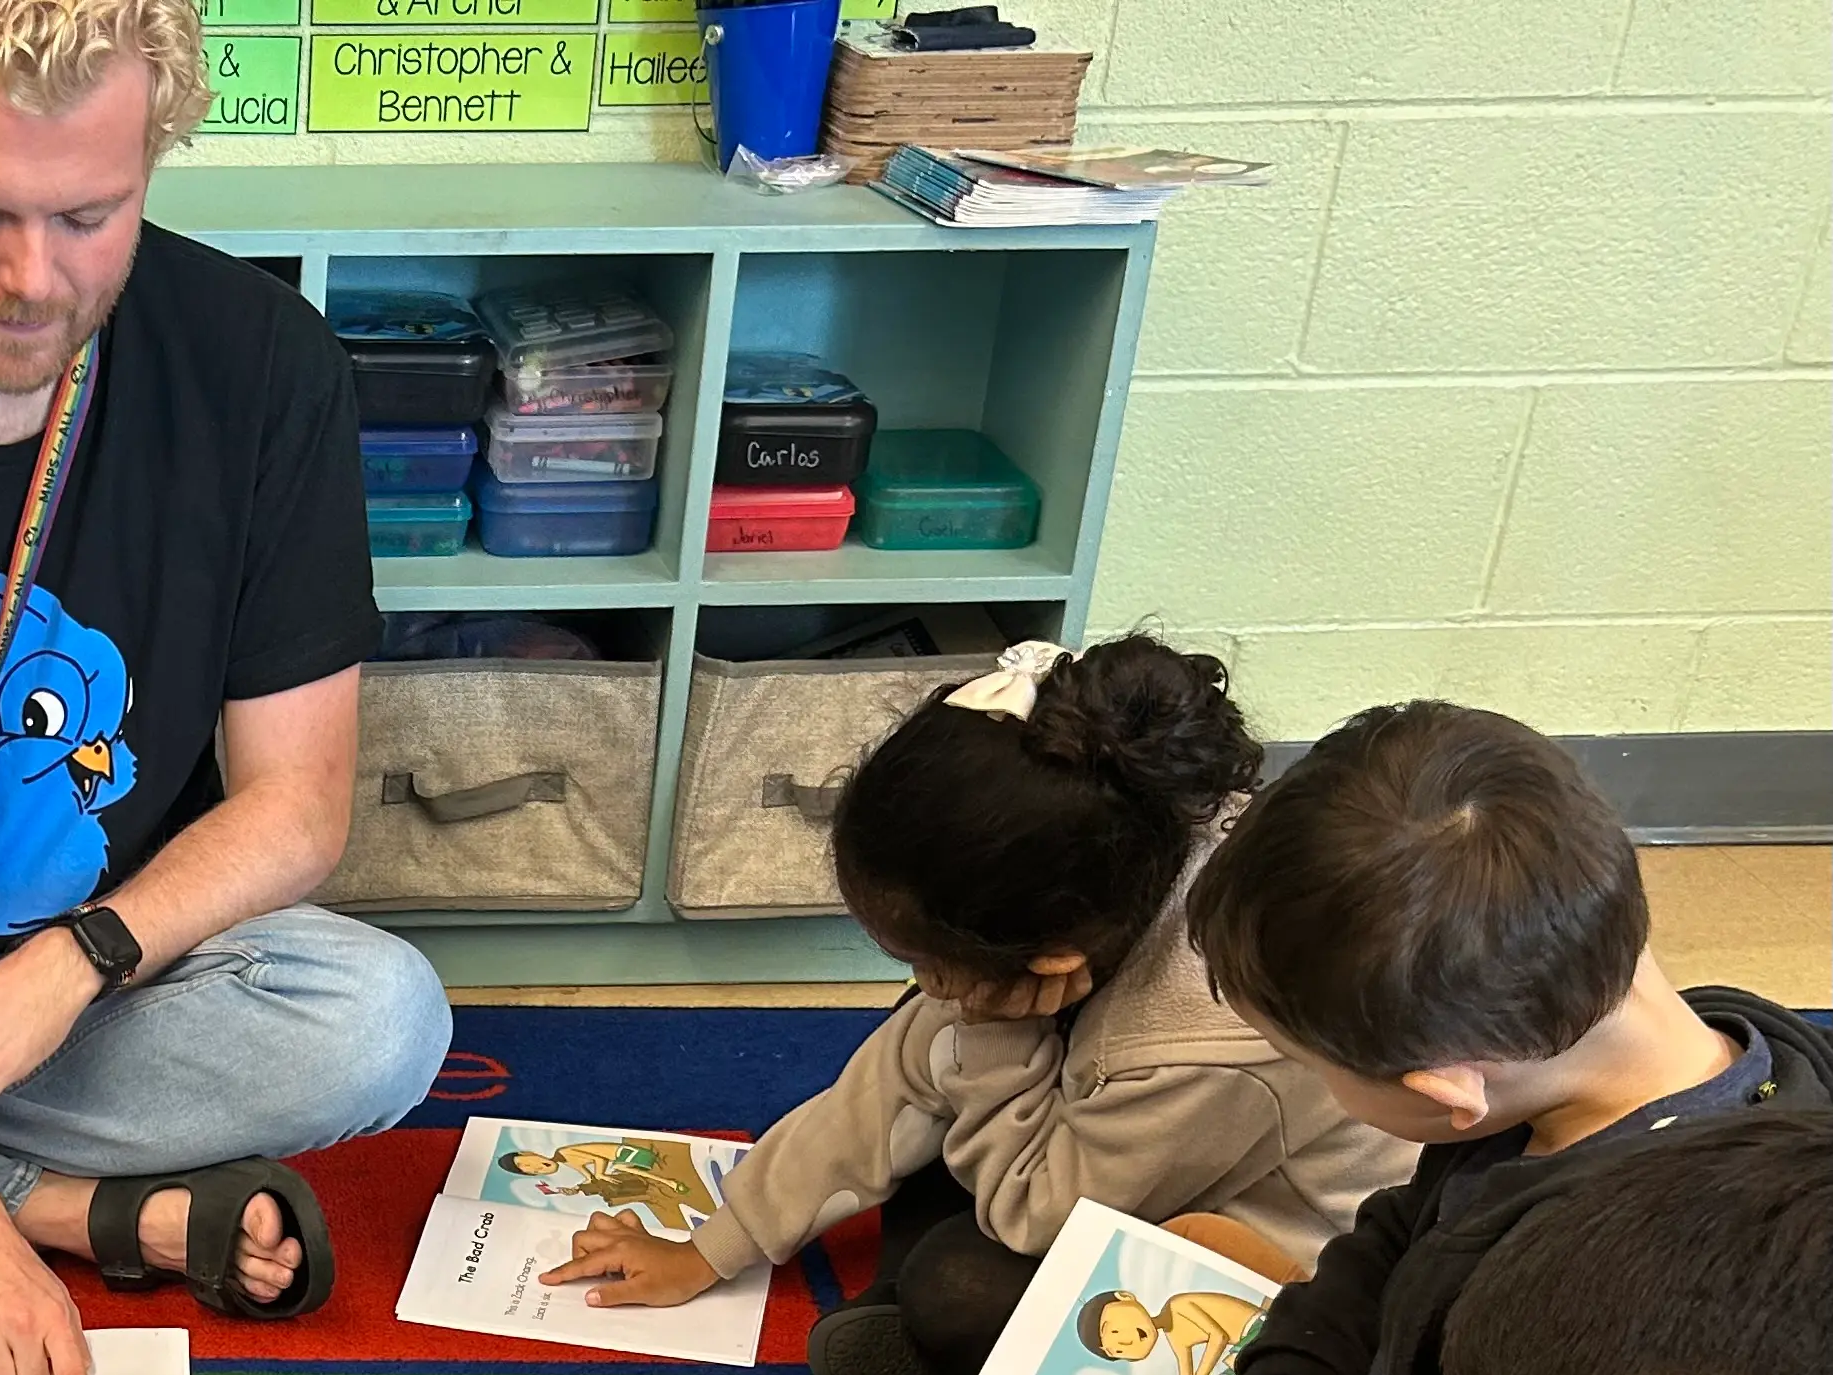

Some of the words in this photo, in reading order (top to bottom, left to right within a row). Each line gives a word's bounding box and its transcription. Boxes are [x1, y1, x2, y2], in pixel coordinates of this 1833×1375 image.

[219, 43, 240, 78] &
[334, 42, 542, 83] Christopher
[551, 41, 572, 75] &
[610, 51, 708, 85] Hailee
[378, 89, 522, 123] Bennett
[39, 458, 60, 503] MNPS
[58, 410, 76, 438] ALL
[747, 441, 820, 468] Carlos
[13, 573, 26, 598] ALL
[473, 1212, 495, 1239] Crab
[465, 1240, 484, 1264] Bad
[458, 1265, 477, 1283] The
